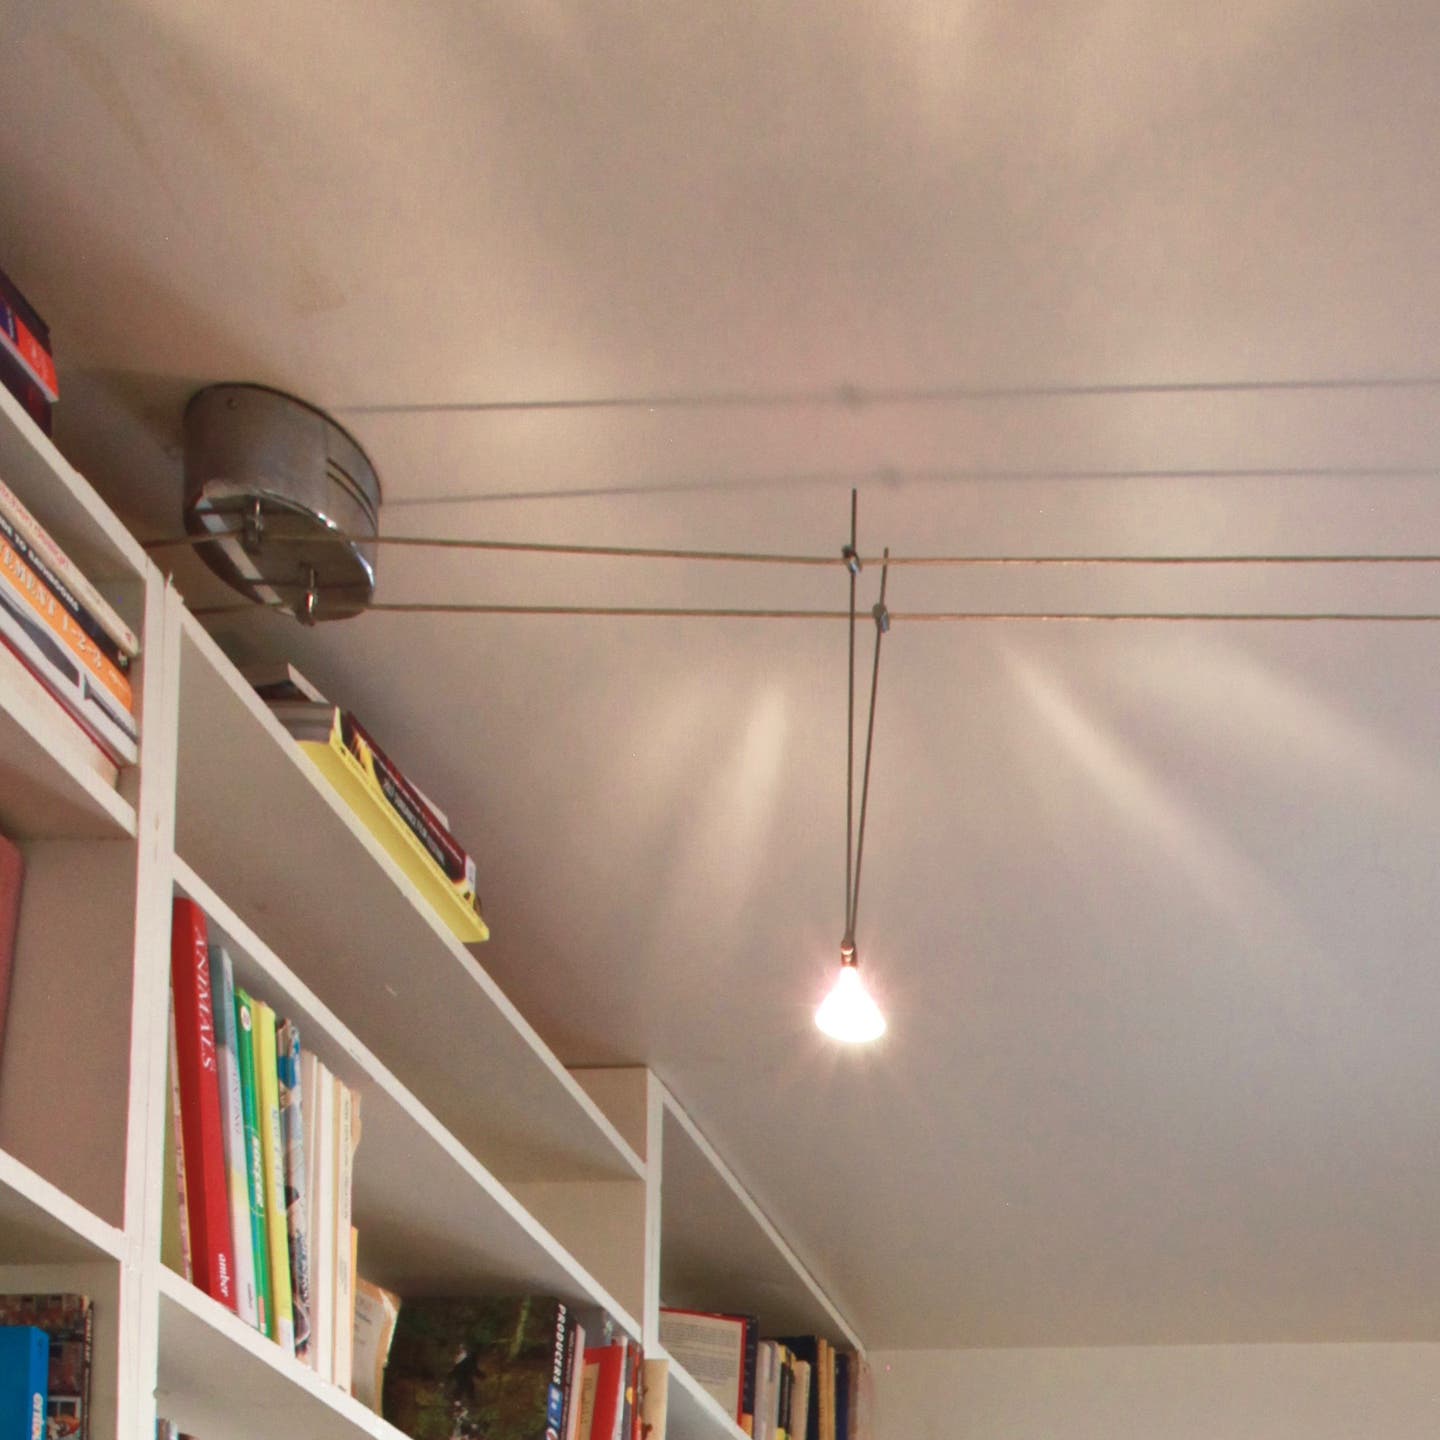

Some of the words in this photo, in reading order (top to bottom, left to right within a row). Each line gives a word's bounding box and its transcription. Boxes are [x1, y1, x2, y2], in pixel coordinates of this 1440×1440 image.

[194, 925, 217, 1073] ANIMALS
[217, 1252, 229, 1298] amber
[552, 1302, 568, 1385] PRODUCERS
